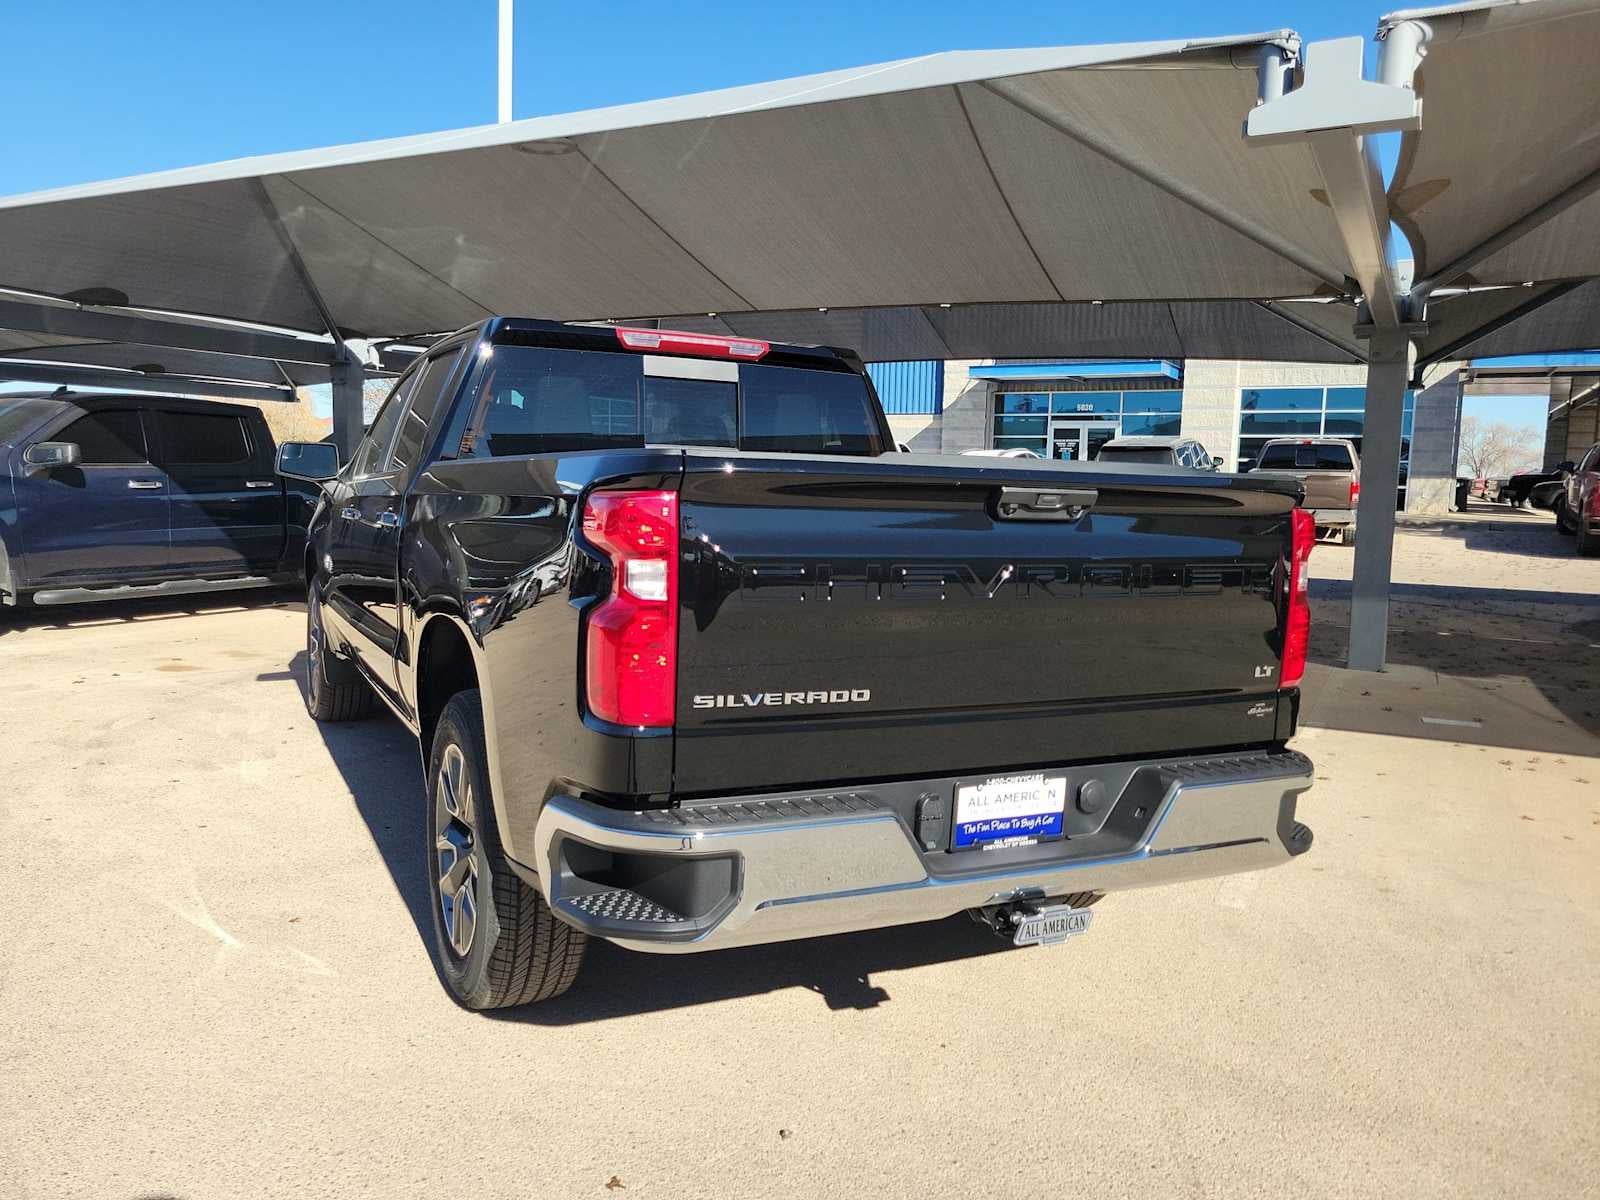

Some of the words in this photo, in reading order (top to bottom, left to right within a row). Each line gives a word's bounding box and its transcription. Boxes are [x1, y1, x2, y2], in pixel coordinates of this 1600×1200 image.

[739, 563, 1271, 601] CHEVROLET
[1254, 665, 1275, 678] LT
[693, 689, 871, 709] SILVERADO
[968, 796, 989, 808] ALL
[994, 789, 1056, 803] AMERICN
[963, 824, 976, 835] The
[991, 819, 1010, 831] Place
[1011, 818, 1020, 828] To
[1021, 817, 1035, 830] Buy
[1035, 816, 1041, 826] A
[1042, 815, 1055, 825] Car
[1025, 923, 1040, 938] ALL
[1042, 915, 1086, 936] AMERICAN
